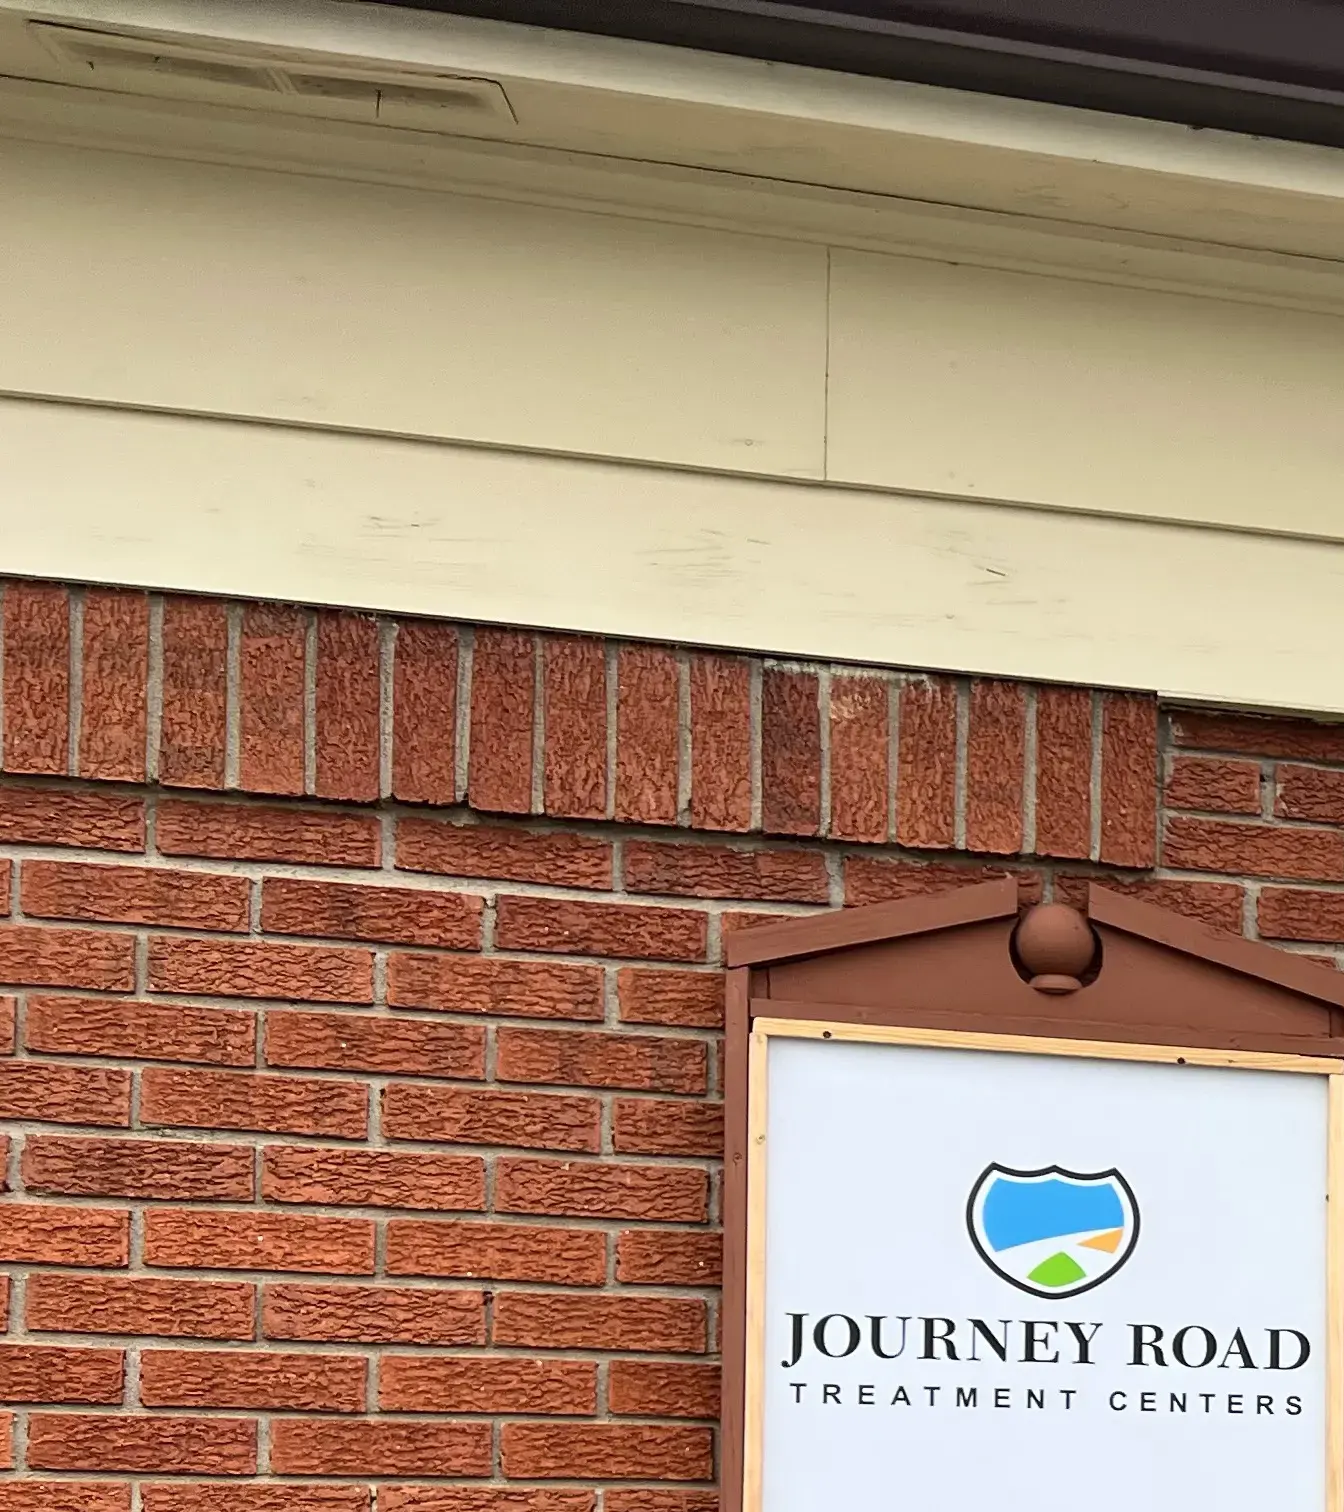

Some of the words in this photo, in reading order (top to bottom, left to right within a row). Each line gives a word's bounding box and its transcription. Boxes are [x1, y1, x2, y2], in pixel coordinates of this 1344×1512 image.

[781, 1312, 1104, 1368] JOURNEY
[1126, 1323, 1311, 1371] ROAD
[789, 1382, 1077, 1410] TREATMENT
[1109, 1390, 1302, 1416] CENTERS
